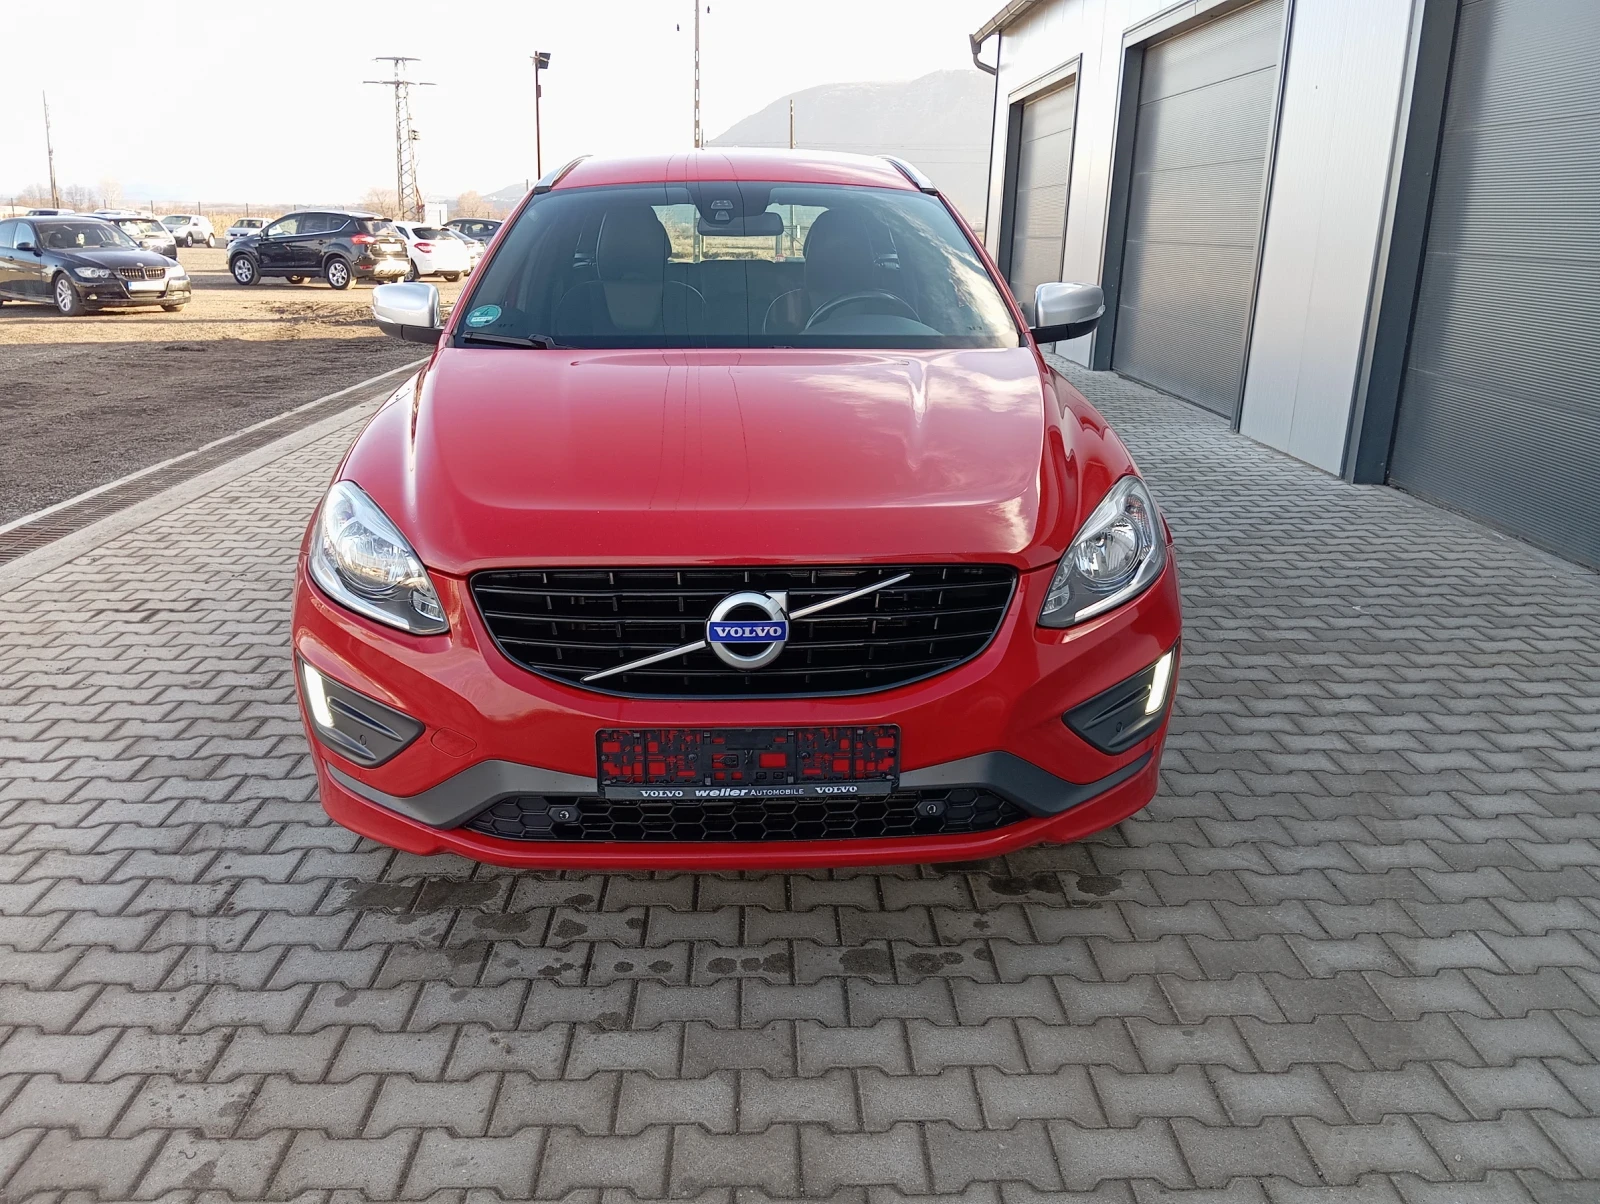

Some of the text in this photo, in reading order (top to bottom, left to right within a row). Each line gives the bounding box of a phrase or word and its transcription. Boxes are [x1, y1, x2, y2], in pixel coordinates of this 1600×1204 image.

[713, 626, 782, 637] VOLVO
[695, 788, 749, 797] weller
[815, 786, 858, 794] VOLVO
